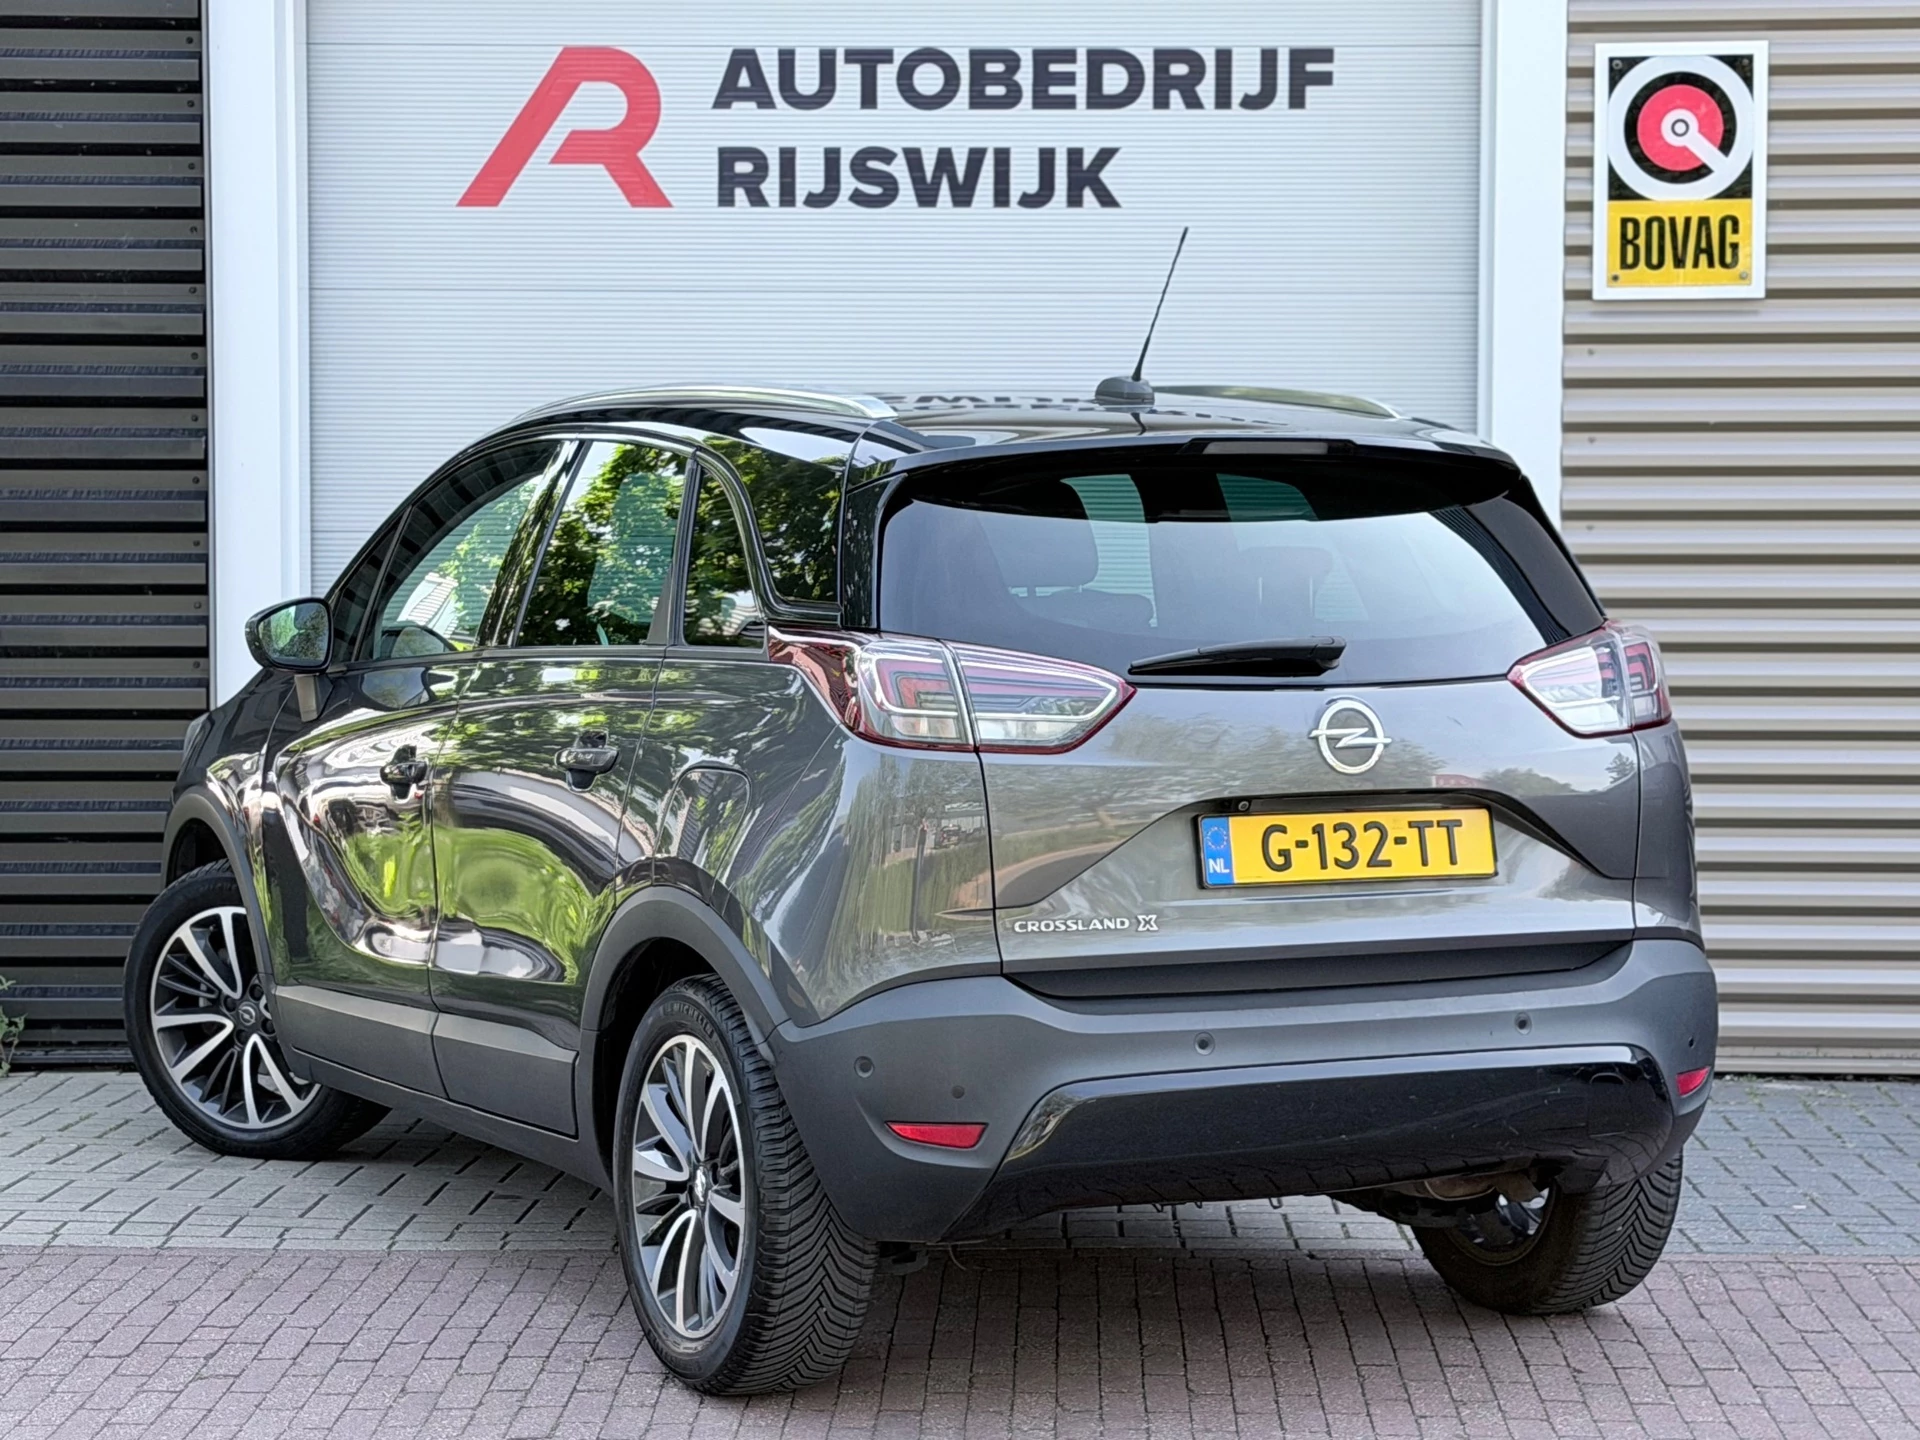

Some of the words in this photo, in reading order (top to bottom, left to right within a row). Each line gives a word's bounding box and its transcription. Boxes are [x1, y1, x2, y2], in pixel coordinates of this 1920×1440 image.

[712, 47, 1334, 111] AUTOBEDRIJF
[716, 146, 1121, 209] RIJSWIJK
[1619, 214, 1740, 271] BOVAG
[1208, 857, 1230, 874] NL
[1261, 818, 1463, 872] G-132-TT
[1013, 917, 1130, 933] CROSSLAND
[1136, 914, 1159, 932] X
